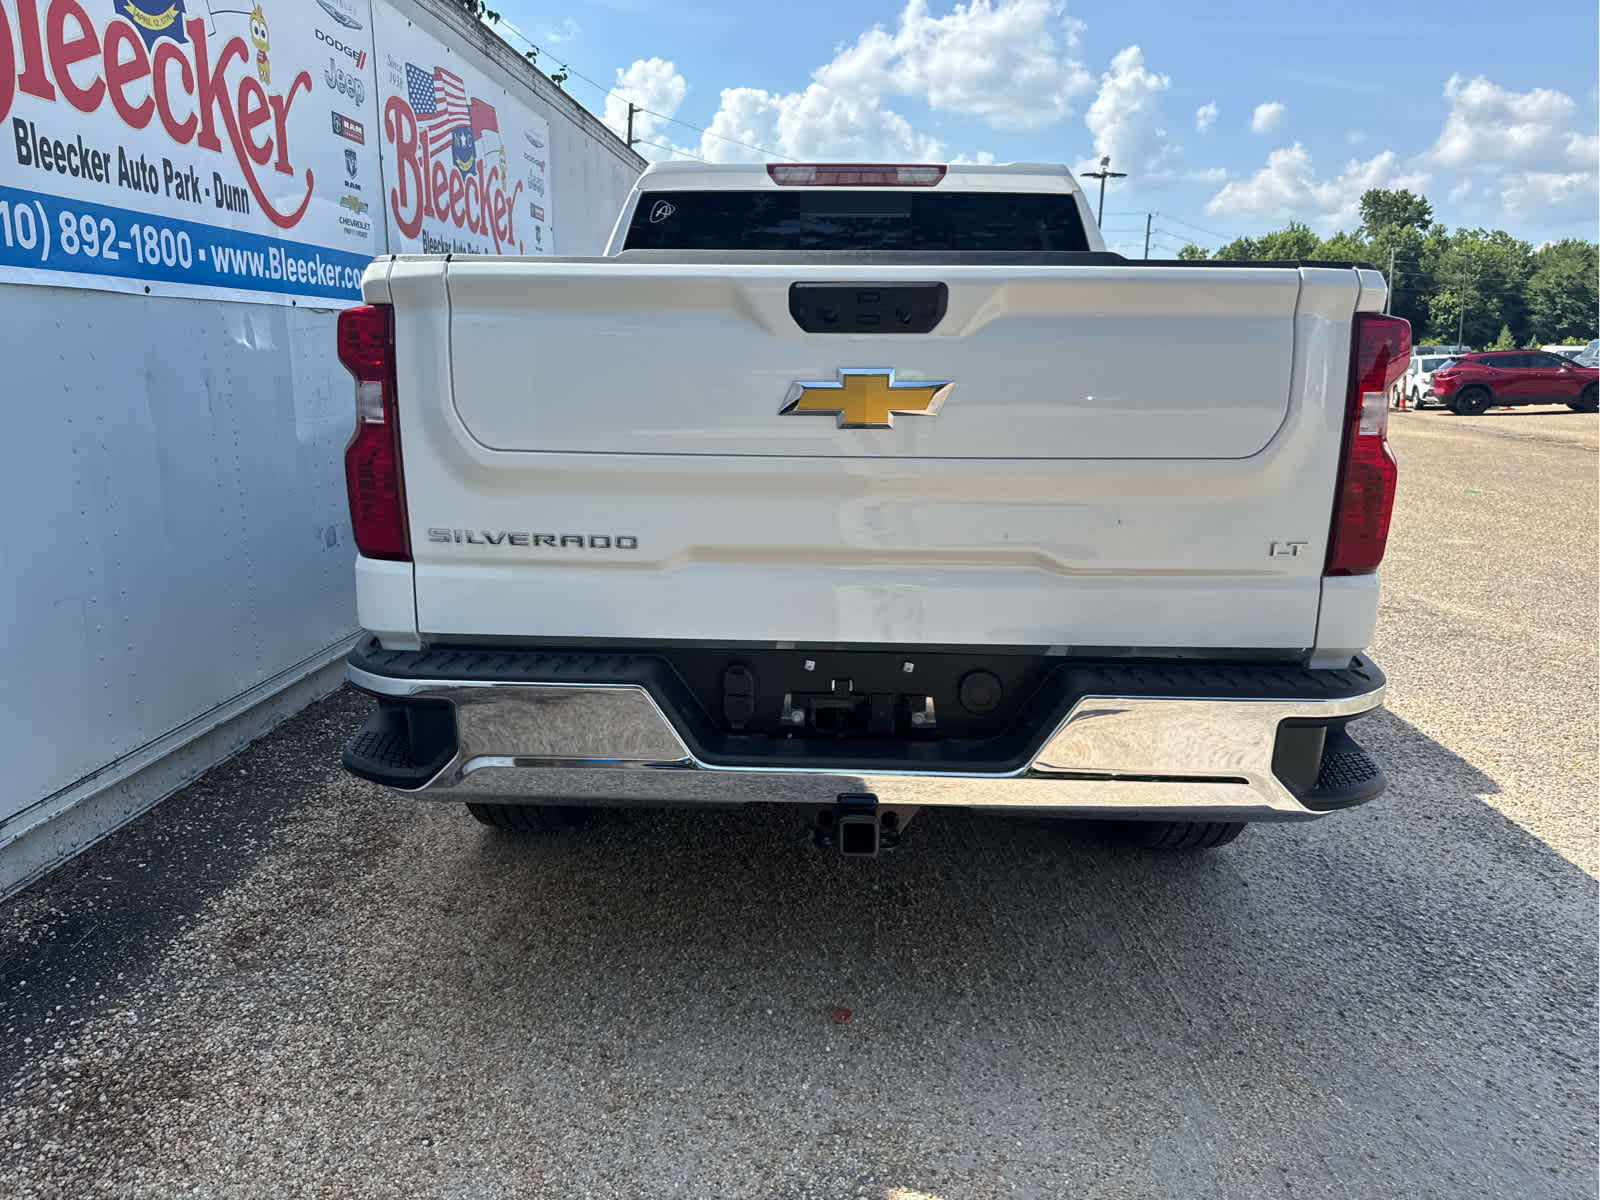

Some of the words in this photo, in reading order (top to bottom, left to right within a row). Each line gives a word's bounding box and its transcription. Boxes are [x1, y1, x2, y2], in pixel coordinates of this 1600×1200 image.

[315, 28, 362, 62] DODGE
[0, 0, 313, 229] leecker
[324, 57, 365, 107] Jeep
[12, 117, 110, 184] Bleecker
[118, 145, 159, 195] Auto
[162, 157, 202, 204] Park
[212, 171, 250, 215] Dunn
[385, 95, 523, 256] Bleecker
[58, 210, 193, 269] 892-1800
[210, 245, 364, 290] www.Bleecker.co
[427, 527, 638, 550] SILVERADO
[1269, 538, 1308, 557] LT
